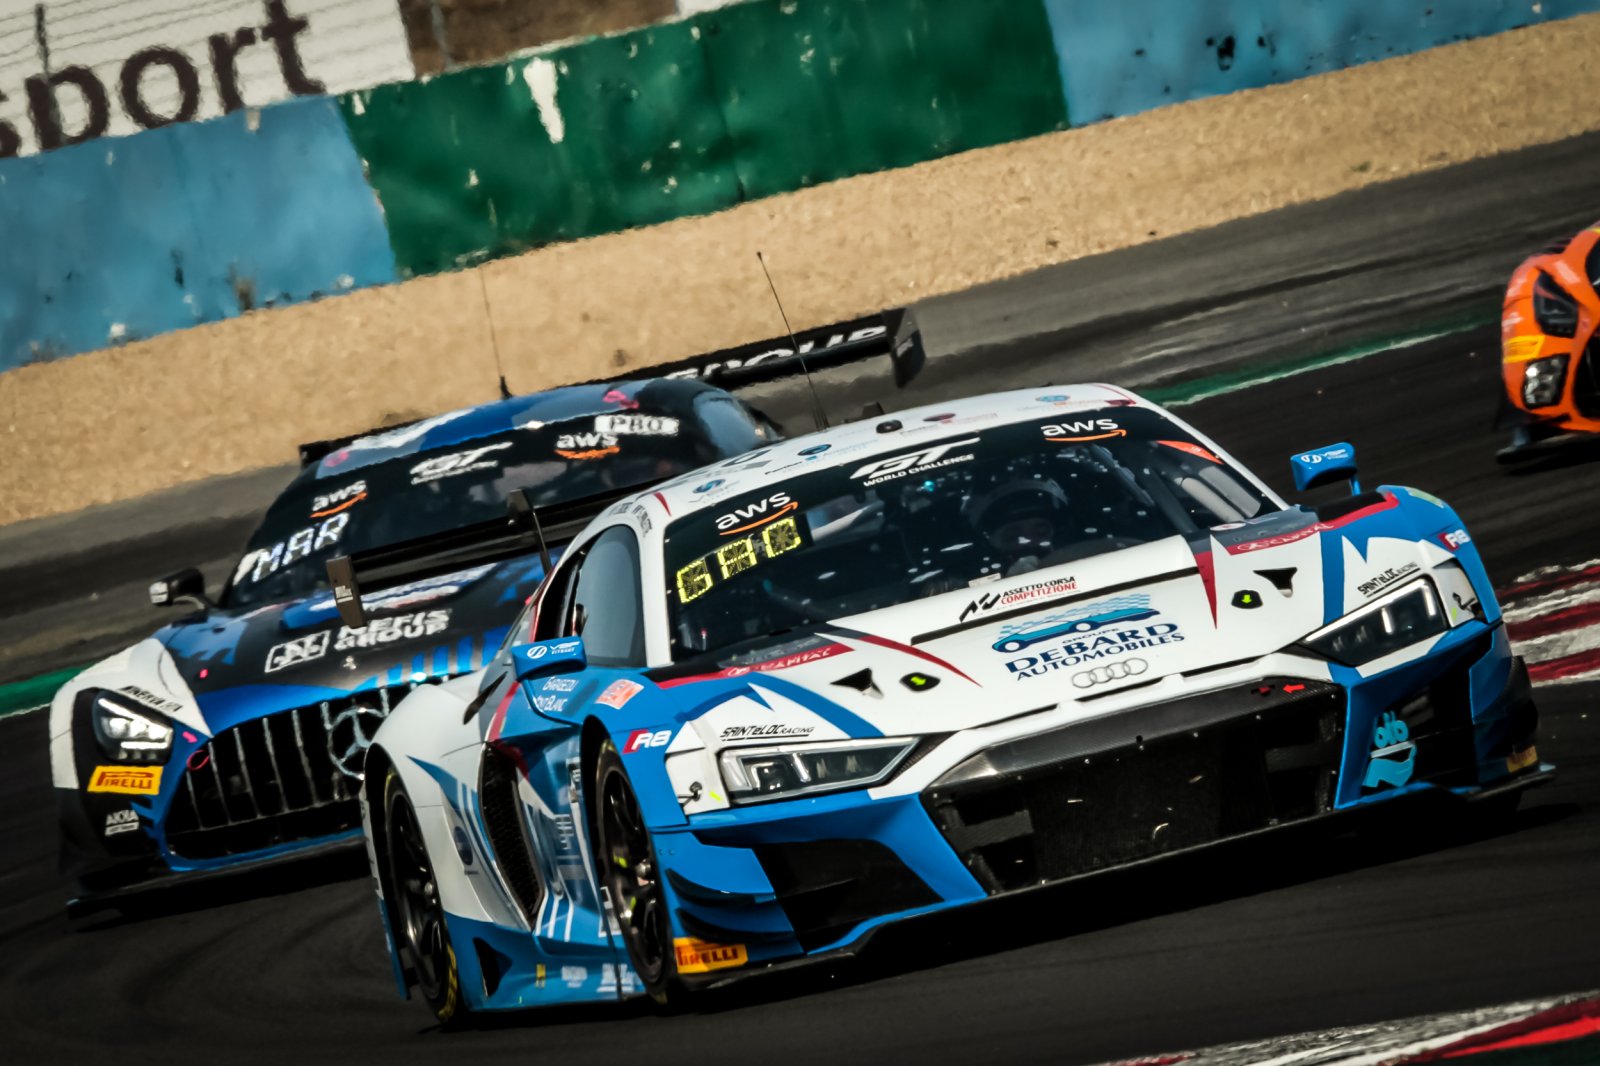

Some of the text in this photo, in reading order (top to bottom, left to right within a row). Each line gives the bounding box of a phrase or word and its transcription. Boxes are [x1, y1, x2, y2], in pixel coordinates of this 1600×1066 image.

[1041, 418, 1119, 437] aws
[556, 432, 618, 448] aws
[850, 437, 981, 480] GT
[863, 453, 975, 487] WORLD CHALLENGE
[312, 479, 367, 511] aws
[715, 491, 791, 530] aws
[251, 512, 350, 583] MAR
[1444, 529, 1471, 548] R8
[1001, 581, 1078, 605] COMPETIZIONE
[1002, 576, 1076, 597] ASSETTO CORSA
[1062, 627, 1119, 644] GROUPE
[1005, 622, 1179, 674] DEBARD
[1017, 632, 1185, 681] AUTOMOBILES
[632, 729, 672, 750] R8
[779, 727, 815, 735] RACING
[96, 771, 154, 789] PIRELLI
[676, 943, 739, 967] PIRELLI
